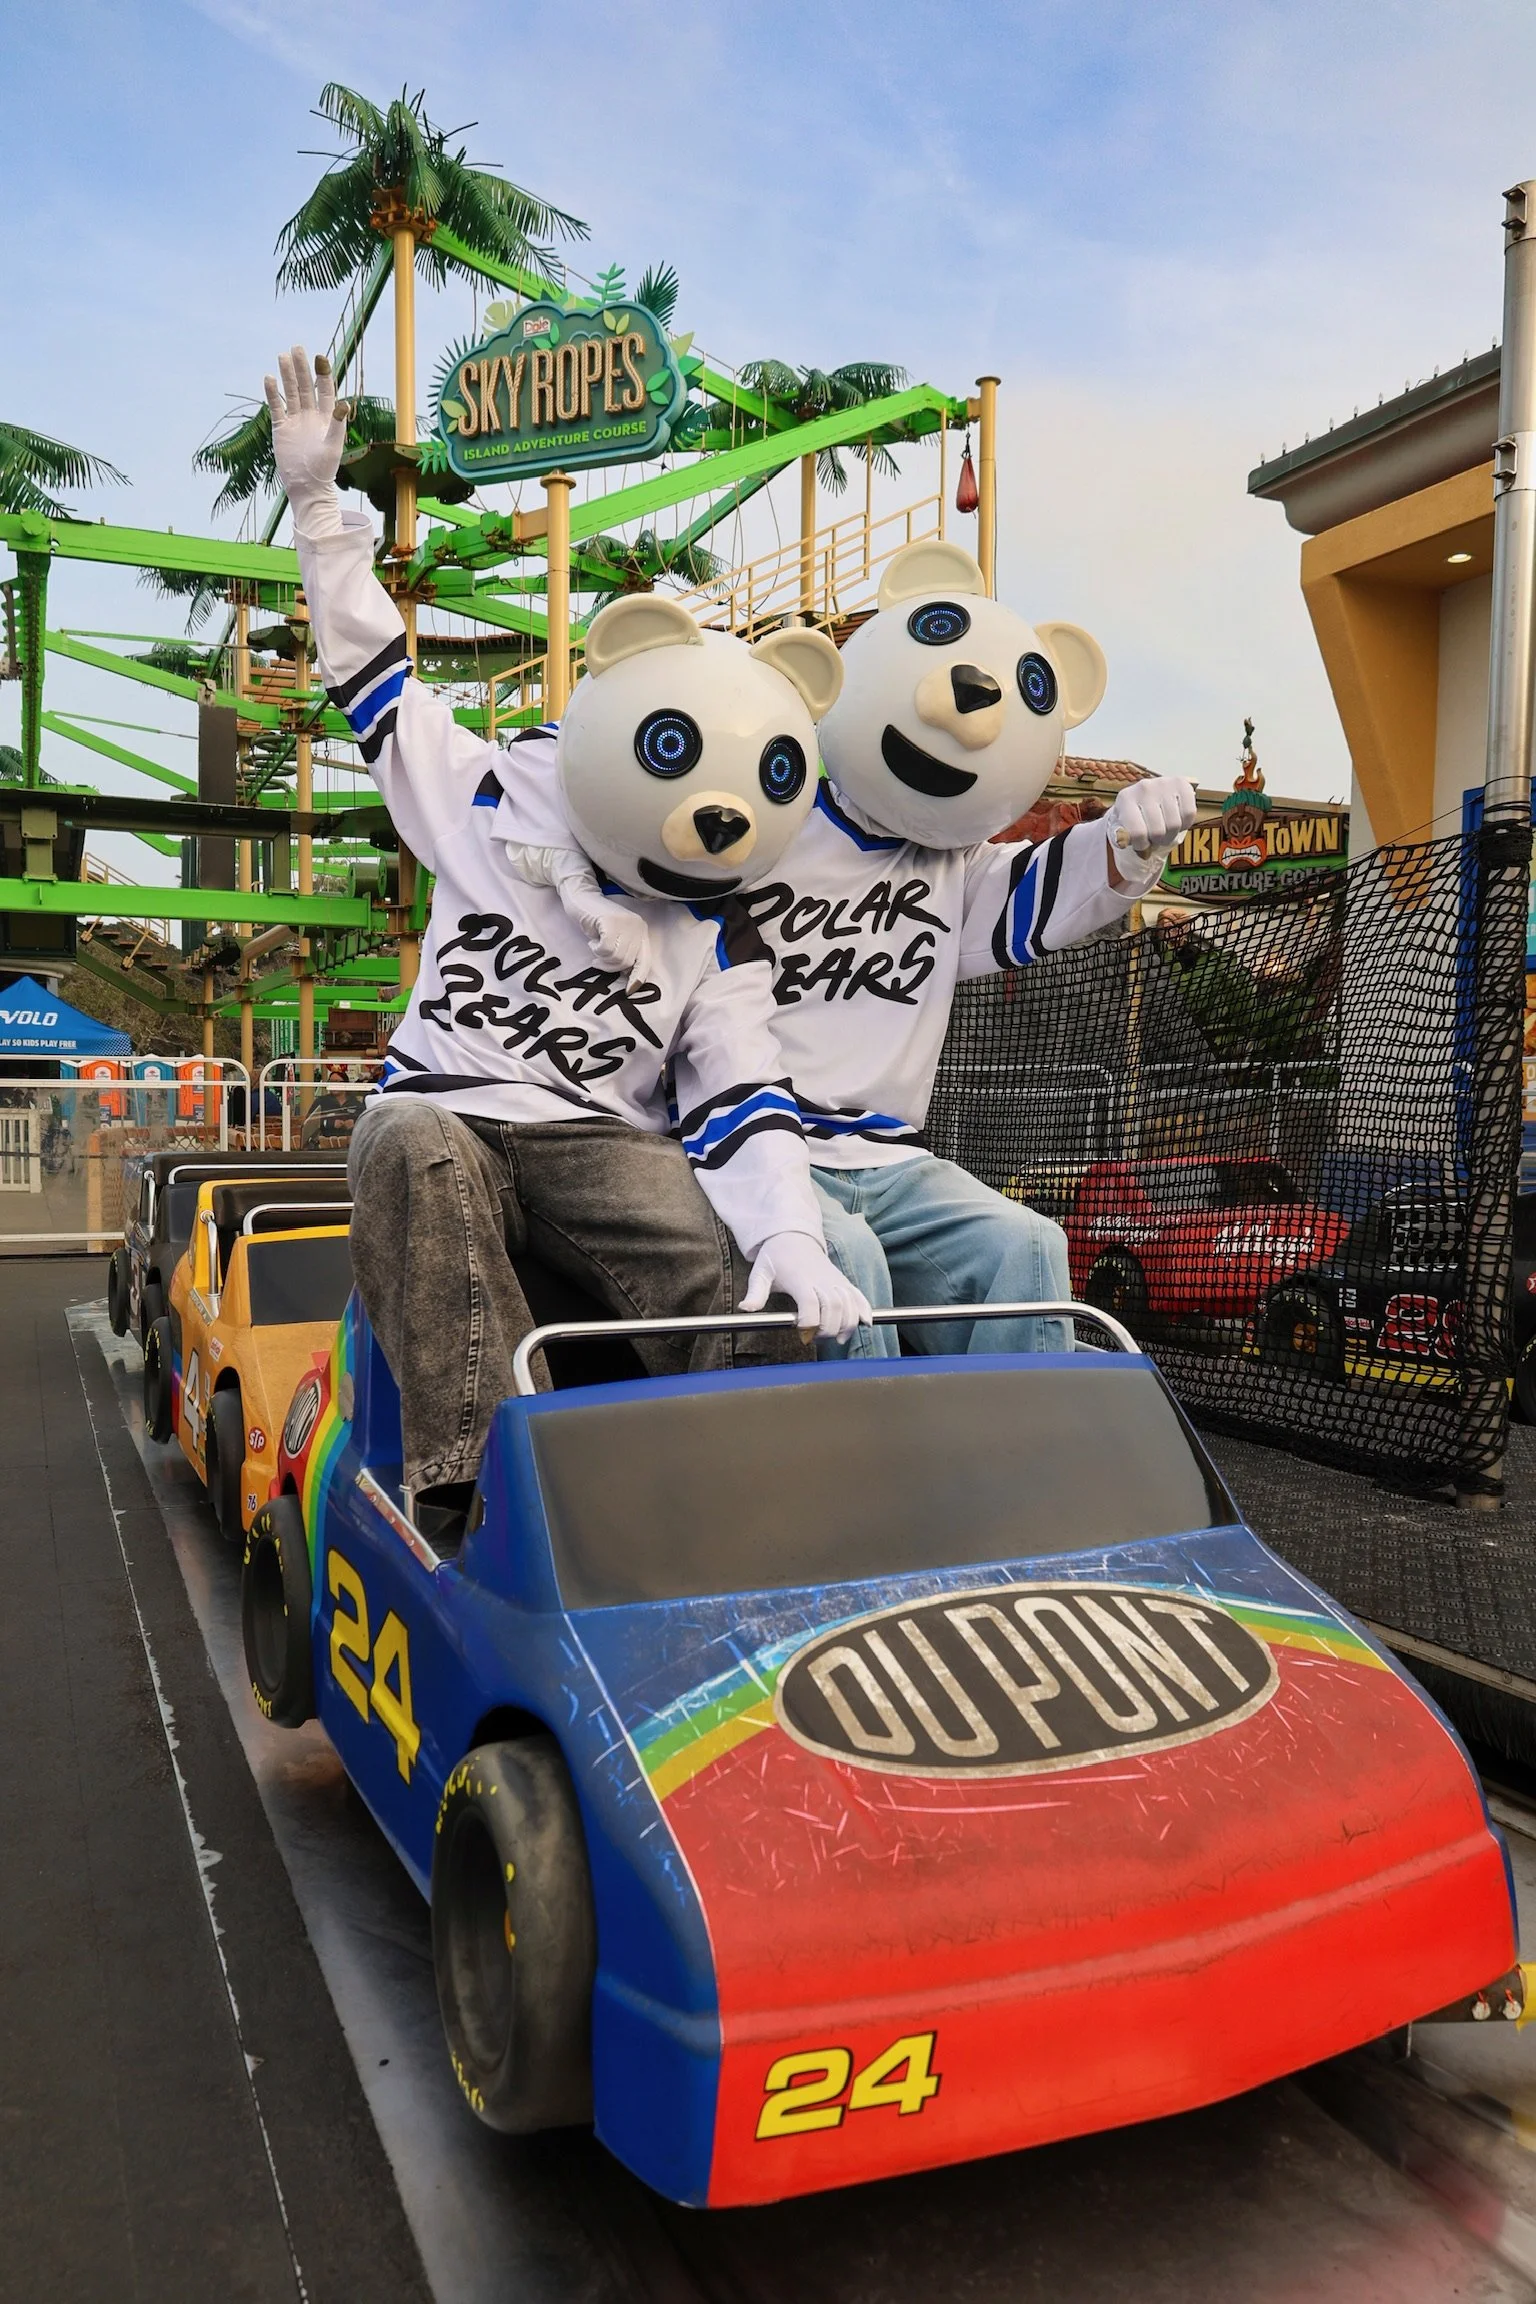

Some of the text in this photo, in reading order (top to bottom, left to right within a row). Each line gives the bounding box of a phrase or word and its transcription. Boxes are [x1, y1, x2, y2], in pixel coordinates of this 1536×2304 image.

[524, 316, 549, 333] Dole
[458, 332, 646, 439] SKY ROPES
[464, 420, 647, 461] ISLAND ADVENTURE COURSE
[742, 878, 951, 943] POLAR
[436, 913, 664, 1049] POLAR
[771, 931, 936, 1006] EARS
[12, 1039, 22, 1047] SO
[23, 1039, 39, 1048] KIDS
[40, 1040, 58, 1048] PLAY
[59, 1041, 77, 1049] FREE
[184, 1347, 206, 1452] 4
[249, 1428, 265, 1449] STP
[247, 1494, 258, 1512] 76
[327, 1548, 421, 1786] 24
[755, 2029, 941, 2142] 24
